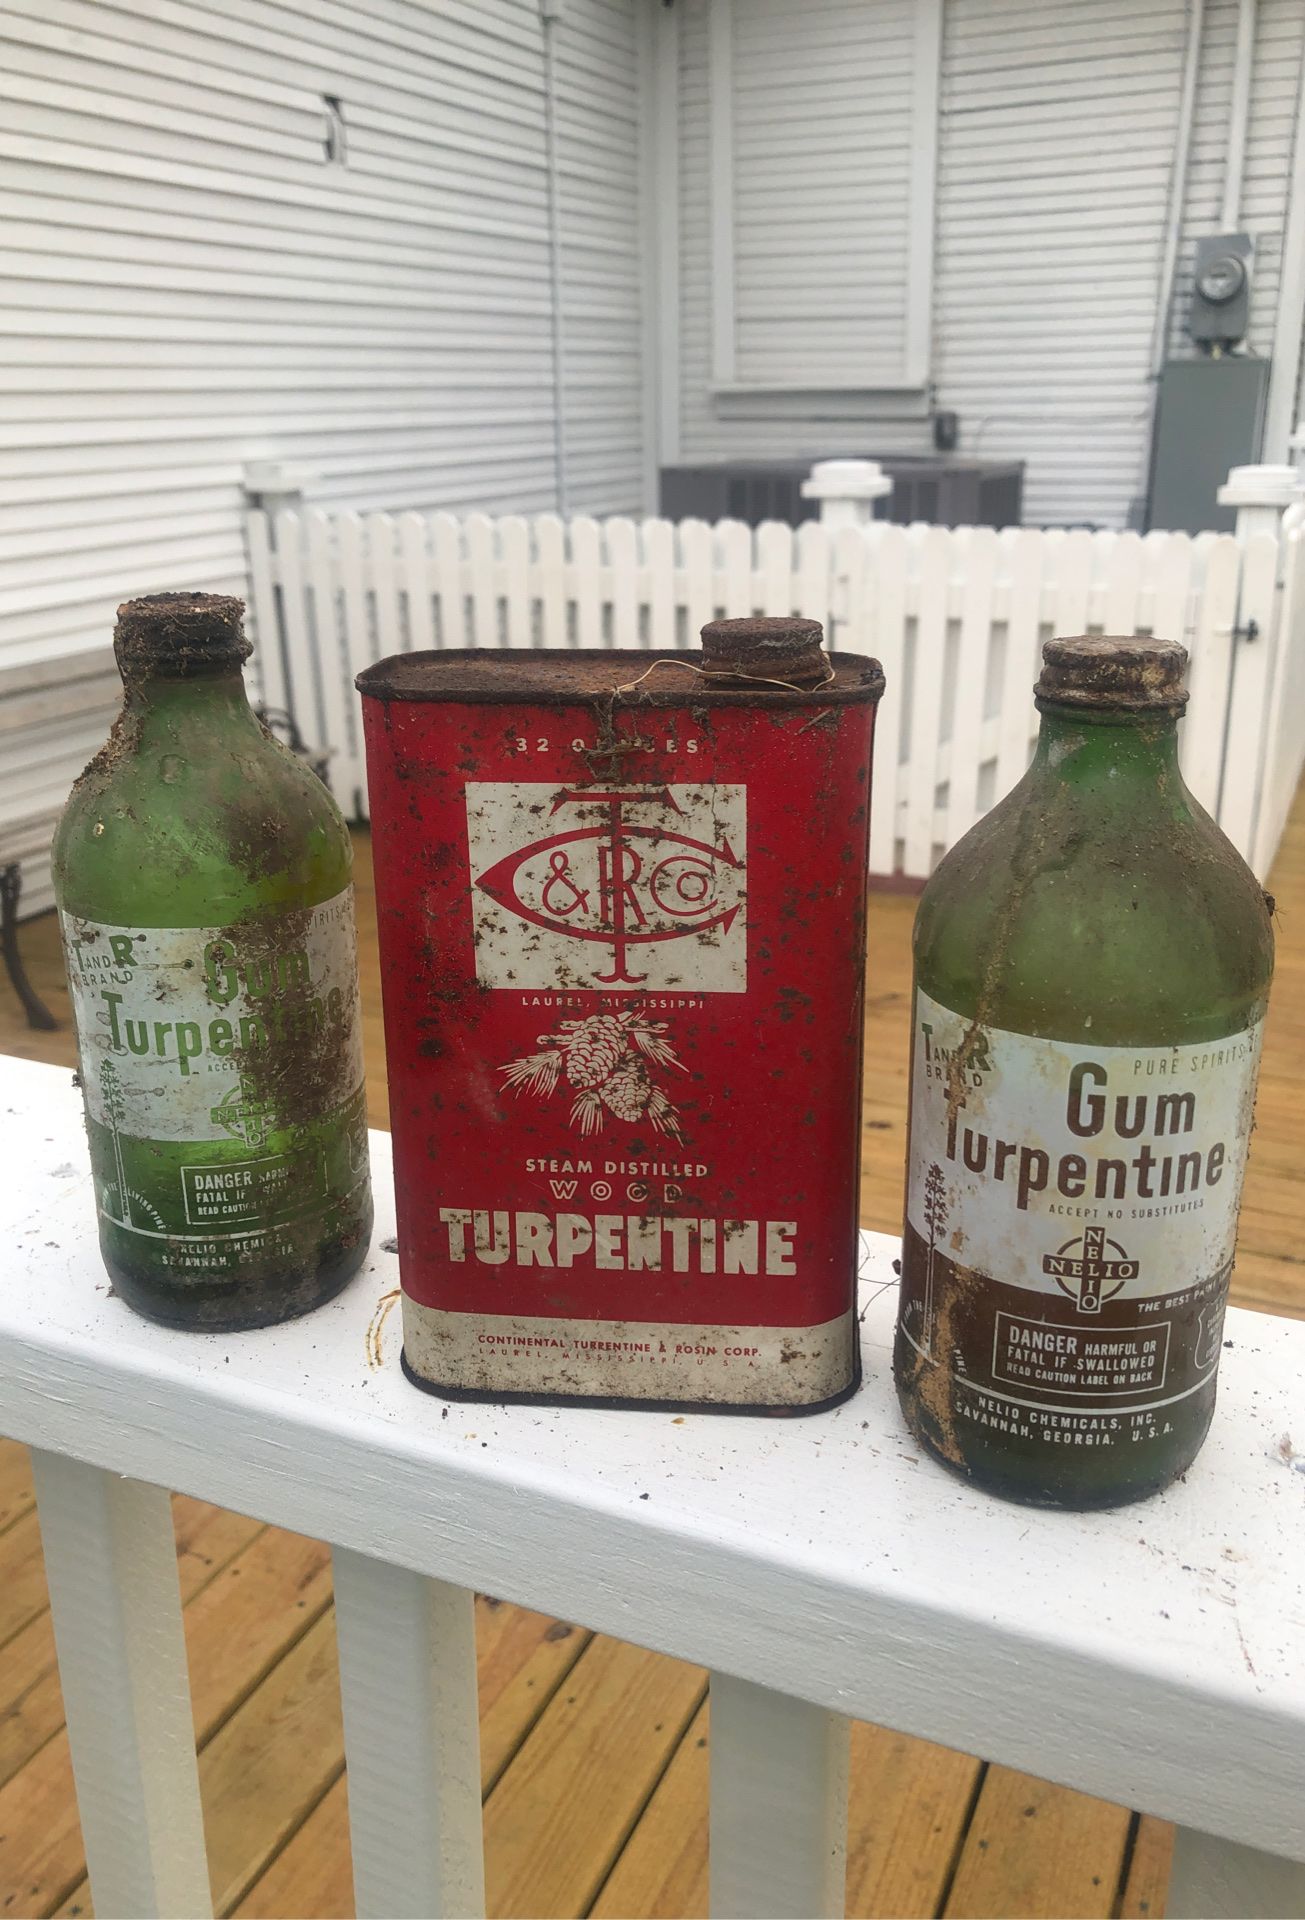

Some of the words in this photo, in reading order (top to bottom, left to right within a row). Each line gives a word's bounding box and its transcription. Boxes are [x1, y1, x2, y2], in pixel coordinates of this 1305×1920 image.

[516, 737, 549, 752] 32
[81, 970, 133, 986] BRAND
[204, 939, 311, 1004] Gum
[1133, 1058, 1179, 1075] PURE
[1191, 1043, 1245, 1072] SPIRITS
[1066, 1062, 1196, 1139] Gum
[944, 1087, 1226, 1210] Turpentine
[526, 1159, 593, 1173] STEAM
[605, 1161, 708, 1177] DISTILLED
[194, 1171, 253, 1190] DANGER
[549, 1180, 682, 1203] WOOD
[196, 1191, 229, 1203] FATAL
[1049, 1204, 1098, 1218] ACCEPT
[1108, 1209, 1123, 1219] NO
[1131, 1198, 1204, 1219] SUBSTITUTES
[198, 1207, 219, 1215] READ
[439, 1208, 798, 1276] TURPENTINE
[1048, 1258, 1134, 1278] NELIO
[1081, 1230, 1103, 1310] NELIO
[1138, 1301, 1161, 1313] THE
[1165, 1294, 1191, 1309] BEST
[478, 1335, 565, 1348] CONTINENTAL
[574, 1341, 651, 1352] TURPENTINE
[659, 1341, 667, 1352] &
[675, 1345, 717, 1356] ROSIN
[724, 1347, 762, 1356] CORP.
[1009, 1325, 1078, 1355] DANGER
[1085, 1343, 1138, 1356] HARMFUL
[1143, 1340, 1157, 1353] OR
[1007, 1346, 1045, 1366] FATAL
[1055, 1356, 1068, 1369] IF
[1076, 1355, 1155, 1371] SWALLOWED
[1006, 1362, 1031, 1377] READ
[1035, 1369, 1076, 1384] CAUTION
[1080, 1376, 1109, 1385] LABEL
[1113, 1375, 1126, 1384] ON
[1130, 1371, 1153, 1383] BACK
[954, 1401, 1033, 1440] SAVANNAH,
[978, 1396, 1019, 1419] NELIO
[1029, 1412, 1122, 1430] CHEMICALS,
[1130, 1413, 1156, 1427] INC.
